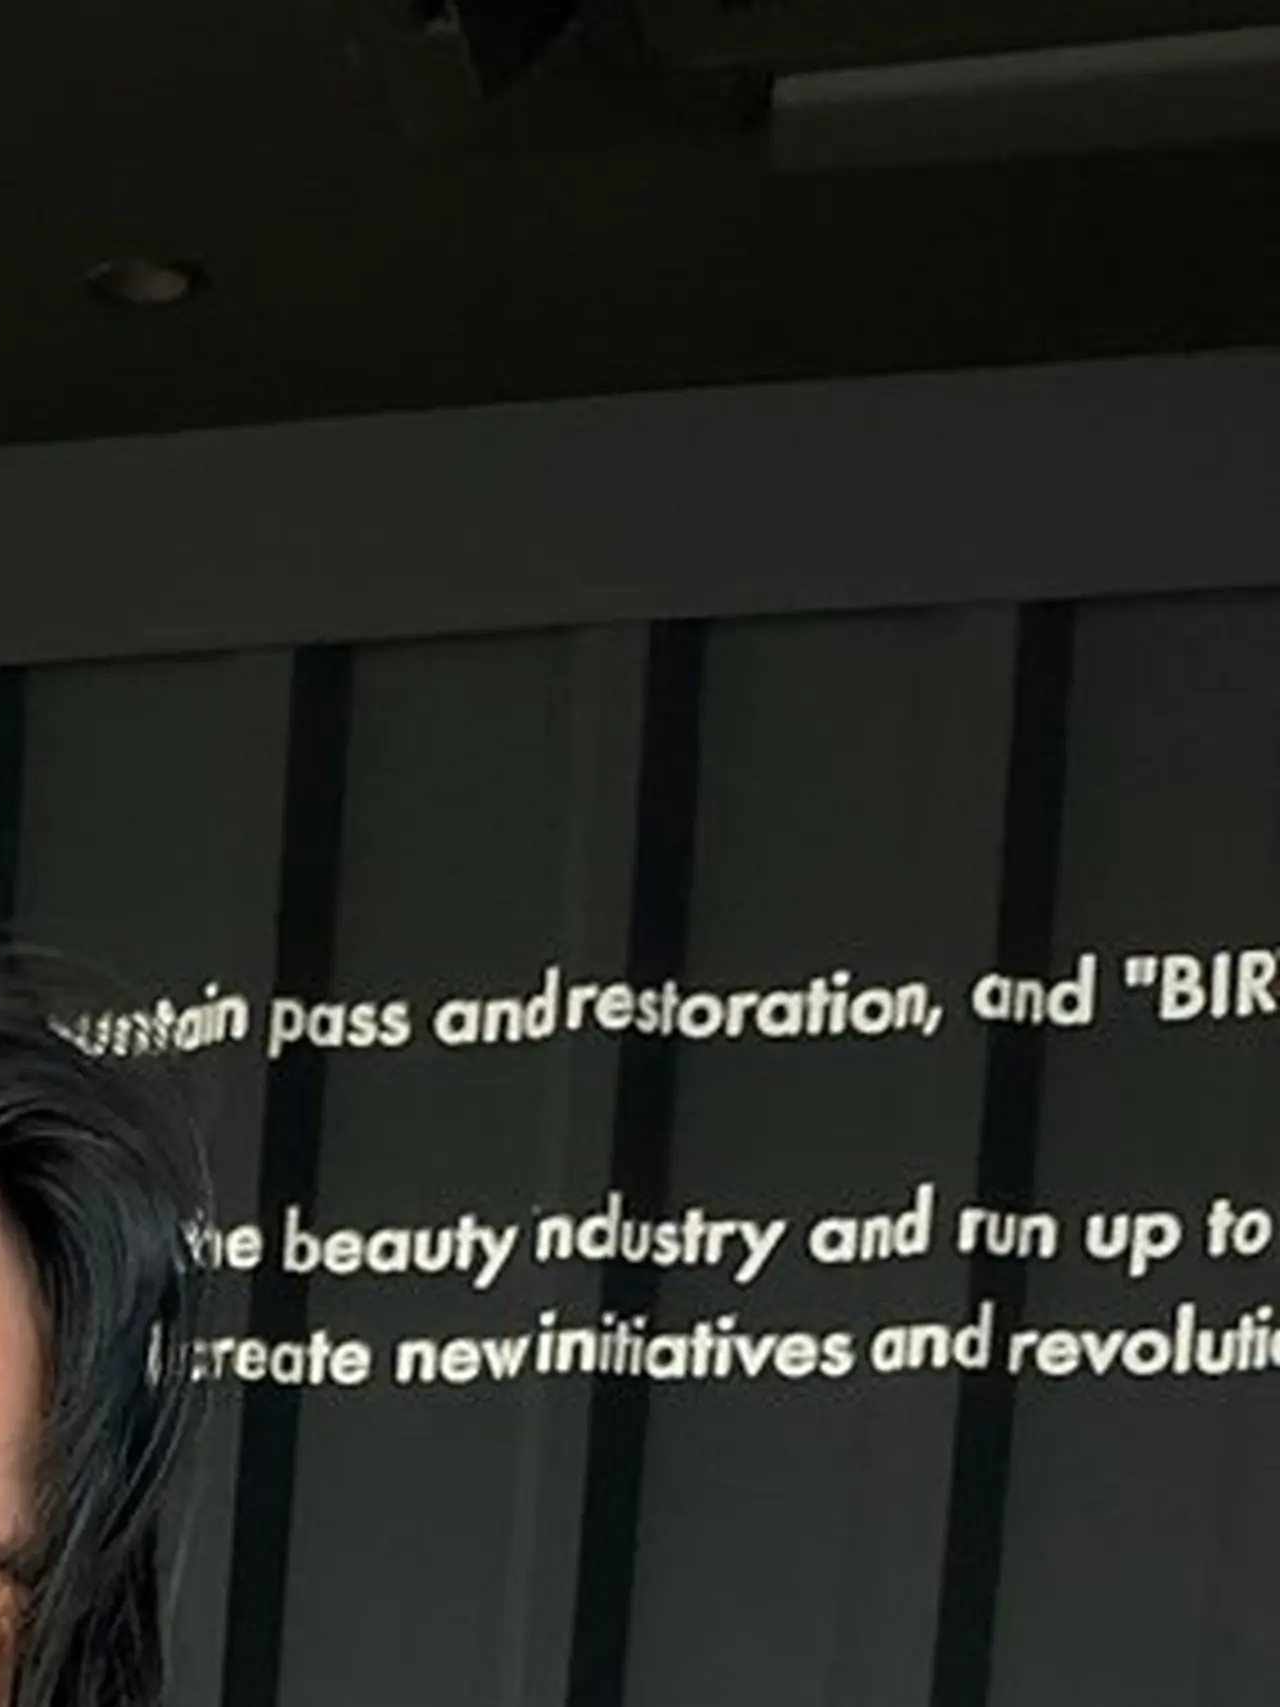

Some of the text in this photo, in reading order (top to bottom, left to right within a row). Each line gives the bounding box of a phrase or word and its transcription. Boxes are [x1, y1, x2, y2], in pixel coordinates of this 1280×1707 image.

[268, 999, 411, 1058] pass
[433, 966, 560, 1046] and
[565, 970, 943, 1039] restoration,
[972, 953, 1097, 1026] and
[1125, 949, 1277, 1021] "BIR
[283, 1206, 519, 1290] beauty
[809, 1182, 934, 1263] and
[957, 1208, 1058, 1258] run
[1085, 1212, 1182, 1278] up
[1207, 1198, 1272, 1257] to
[395, 1334, 532, 1384] new
[535, 1309, 856, 1380] initiatives
[870, 1300, 994, 1373] and
[1008, 1302, 1280, 1376] revoluti
